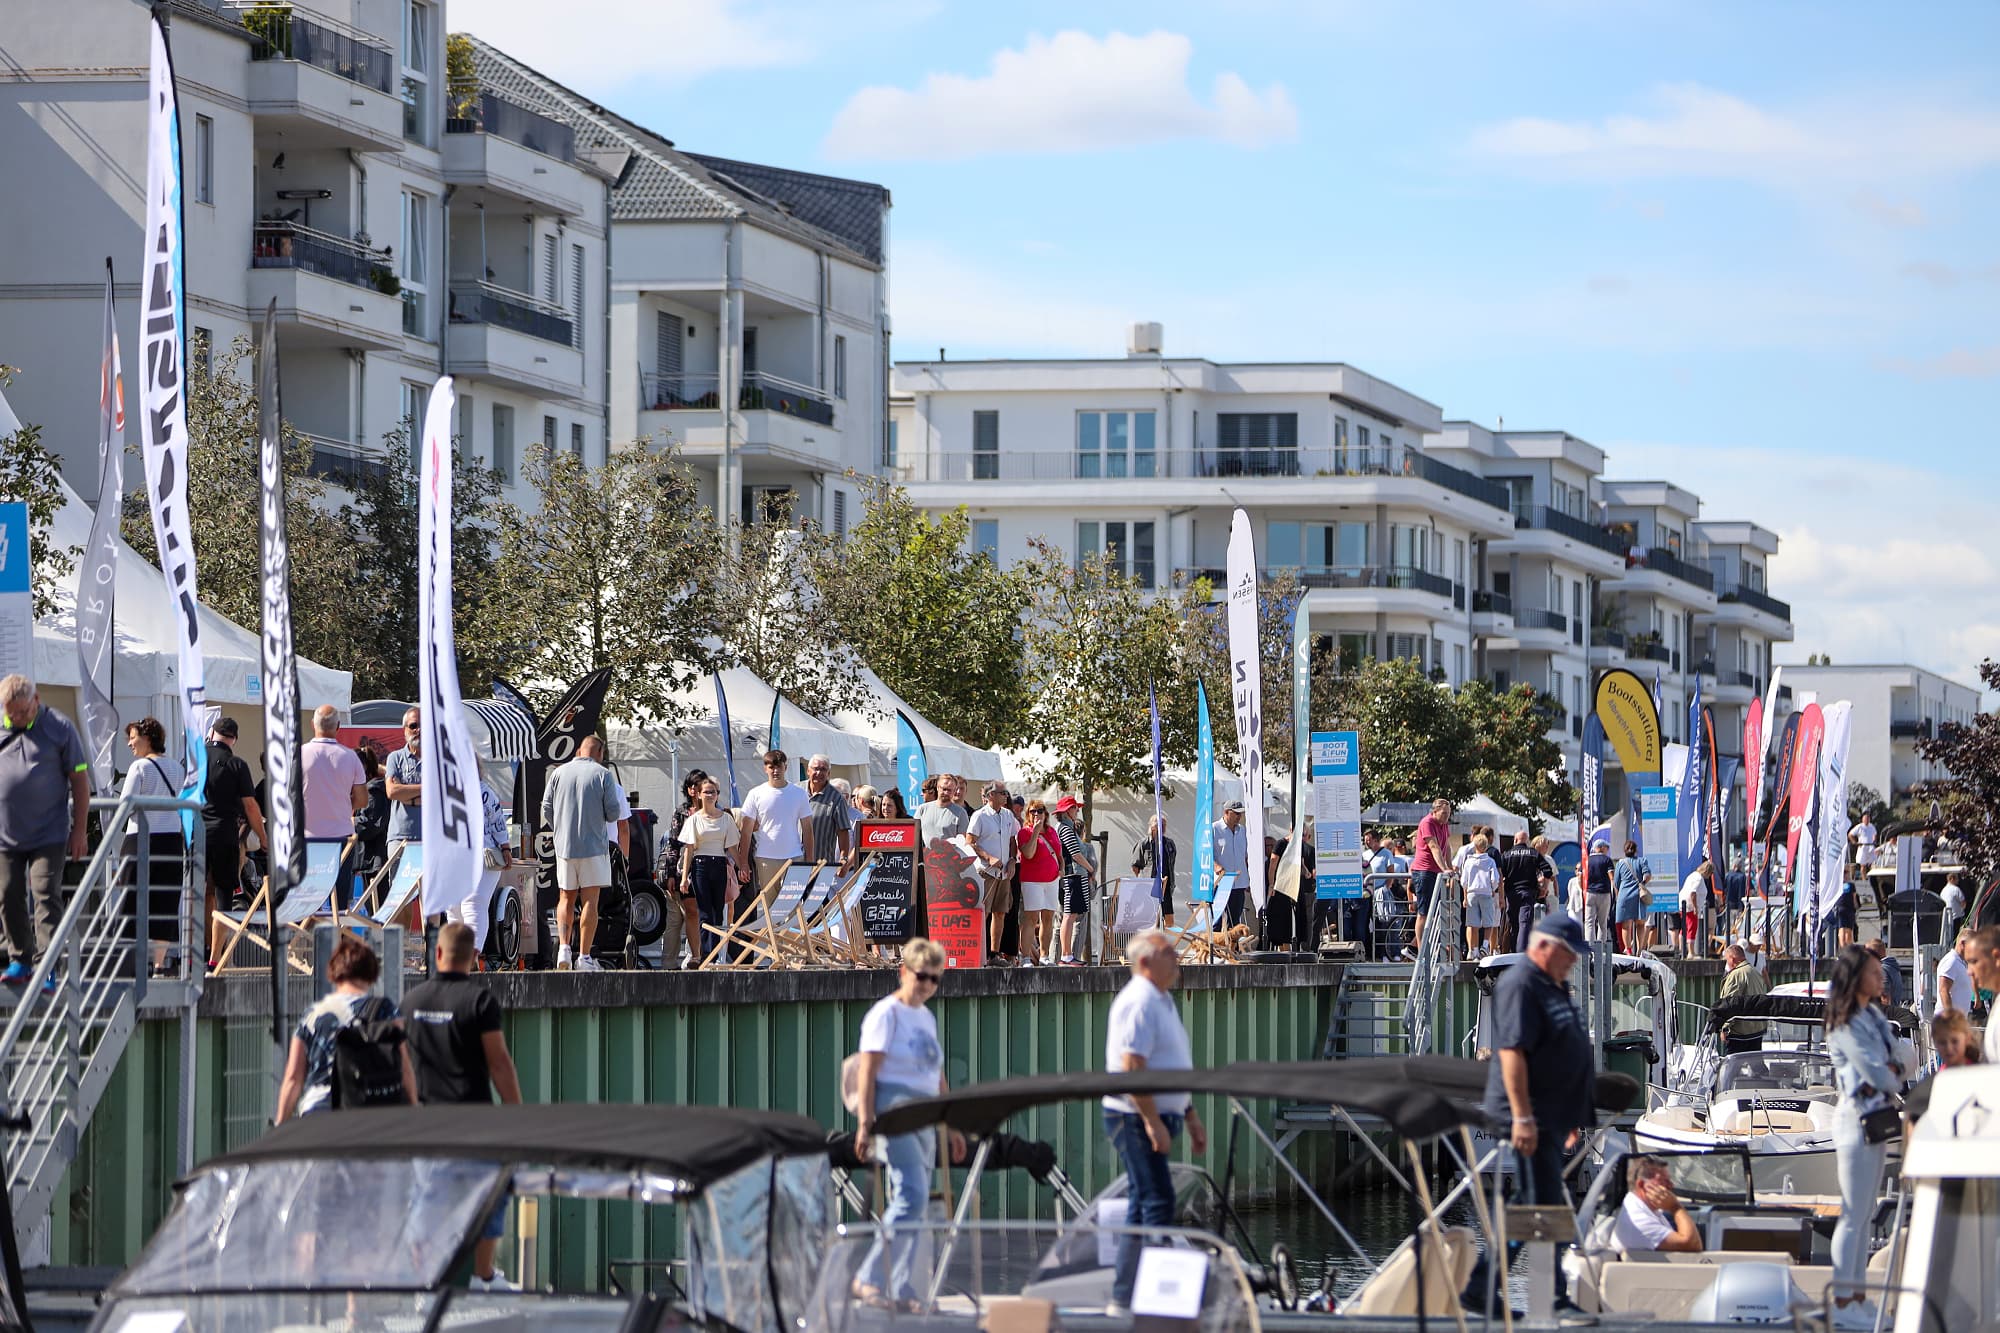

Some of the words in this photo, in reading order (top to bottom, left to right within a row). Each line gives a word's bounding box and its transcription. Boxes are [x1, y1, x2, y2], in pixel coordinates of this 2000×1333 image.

[1607, 680, 1655, 763] Bootssattlerei
[1330, 749, 1347, 757] FUN
[1583, 751, 1591, 806] YACHTEN
[862, 888, 906, 901] Cocktails
[869, 923, 898, 931] JETZT
[941, 914, 972, 929] DAYS
[945, 948, 966, 957] ERLIN
